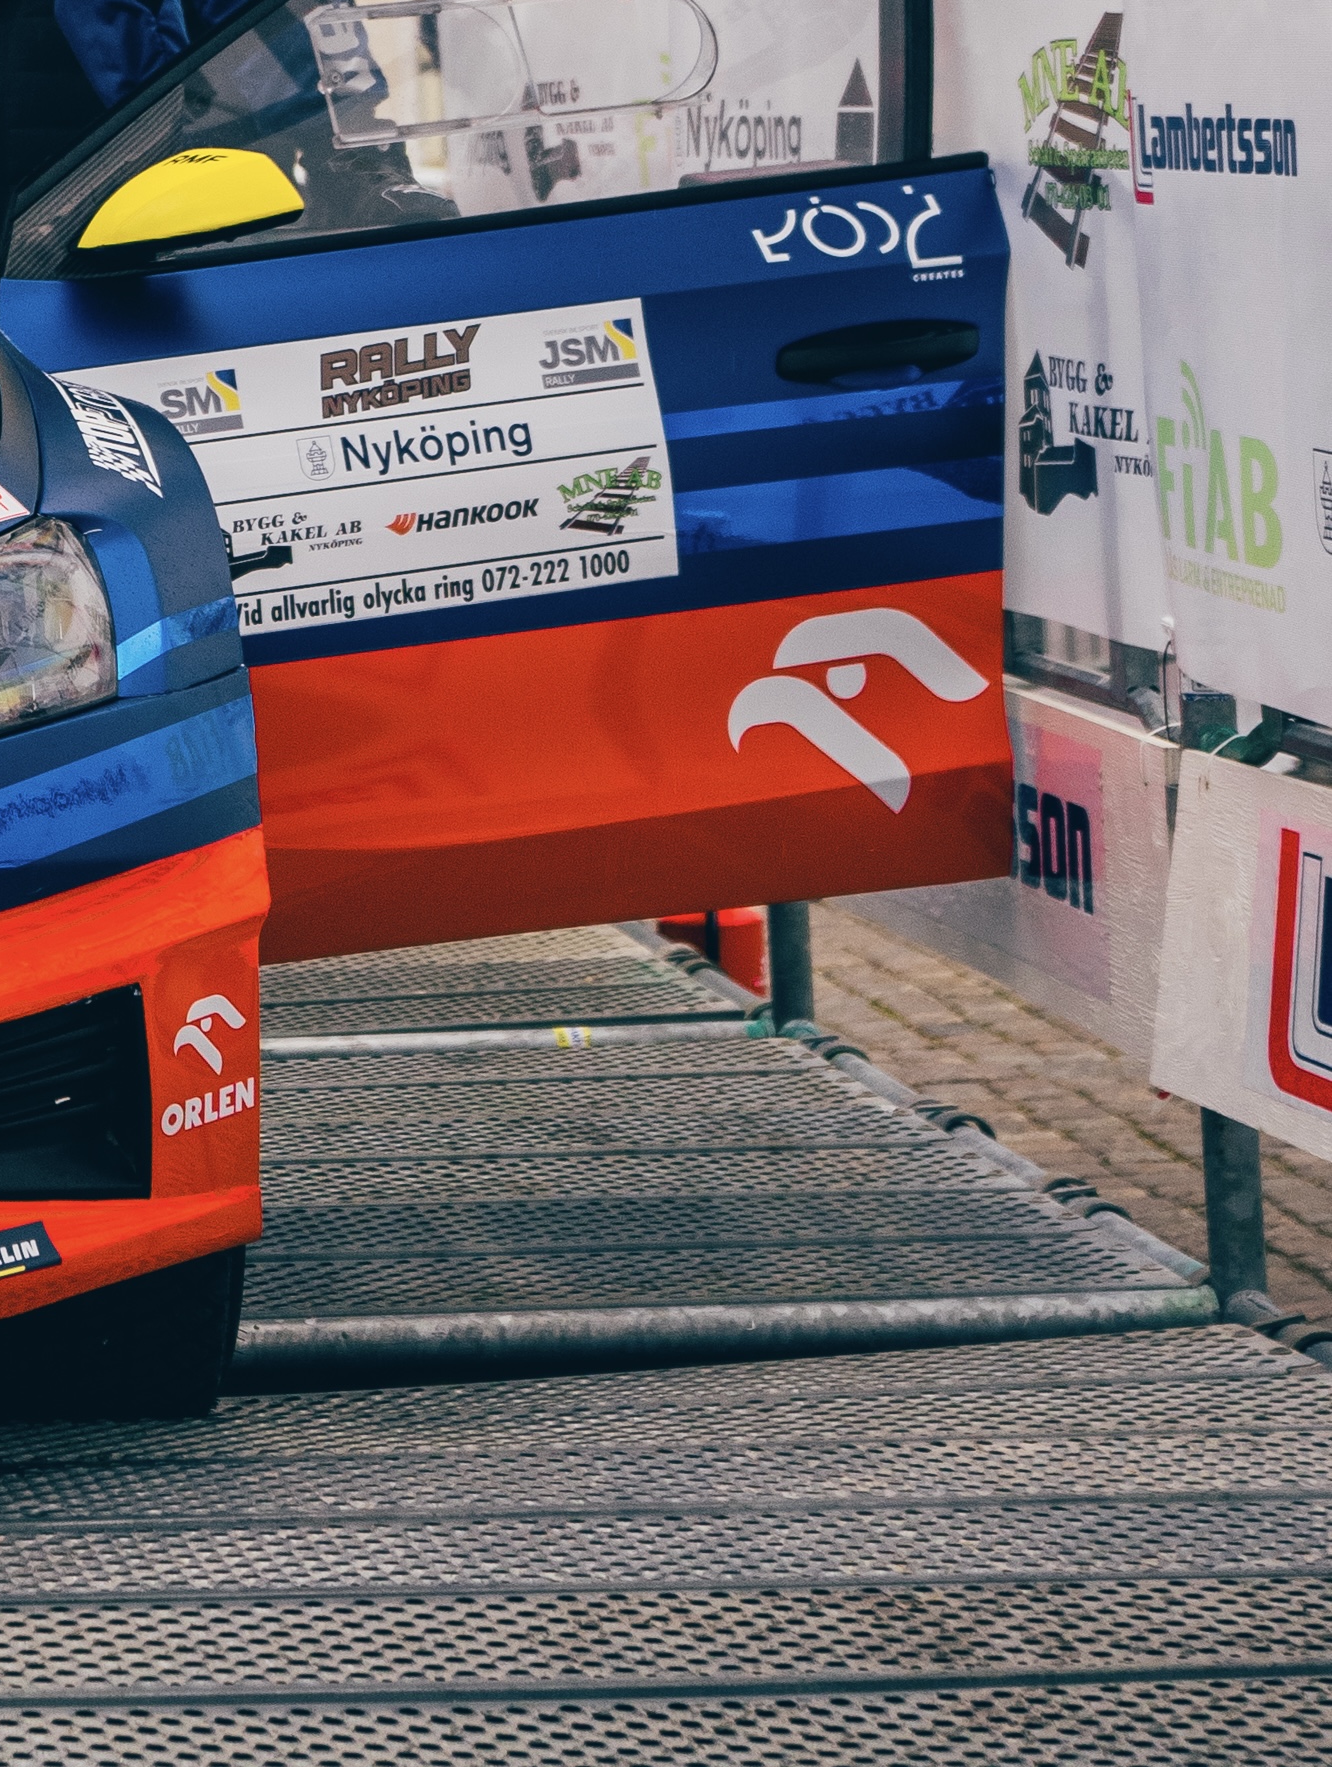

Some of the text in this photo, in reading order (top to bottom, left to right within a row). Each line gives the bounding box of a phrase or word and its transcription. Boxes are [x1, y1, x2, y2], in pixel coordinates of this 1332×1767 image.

[686, 98, 802, 170] Nyköping
[1138, 102, 1297, 177] Lambertsson
[912, 269, 965, 283] CREATES
[320, 323, 482, 392] RALLY
[539, 334, 620, 370] JSM
[321, 368, 471, 419] NYKÖPING
[544, 373, 576, 387] RALLY
[1048, 356, 1113, 396] BYGG &
[160, 385, 223, 420] SM
[1069, 402, 1139, 444] KAKEL
[340, 420, 533, 475] Nyköping
[556, 468, 619, 504] MNE
[232, 512, 307, 534] BYGG &
[261, 520, 362, 546] KAKEL AB
[308, 538, 363, 552] NYKÖPING
[271, 588, 355, 618] allvarlig
[363, 578, 426, 614] olycka
[434, 575, 474, 602] ring
[482, 558, 569, 593] 072-222
[579, 550, 630, 579] 1000
[161, 1077, 255, 1136] ORLEN
